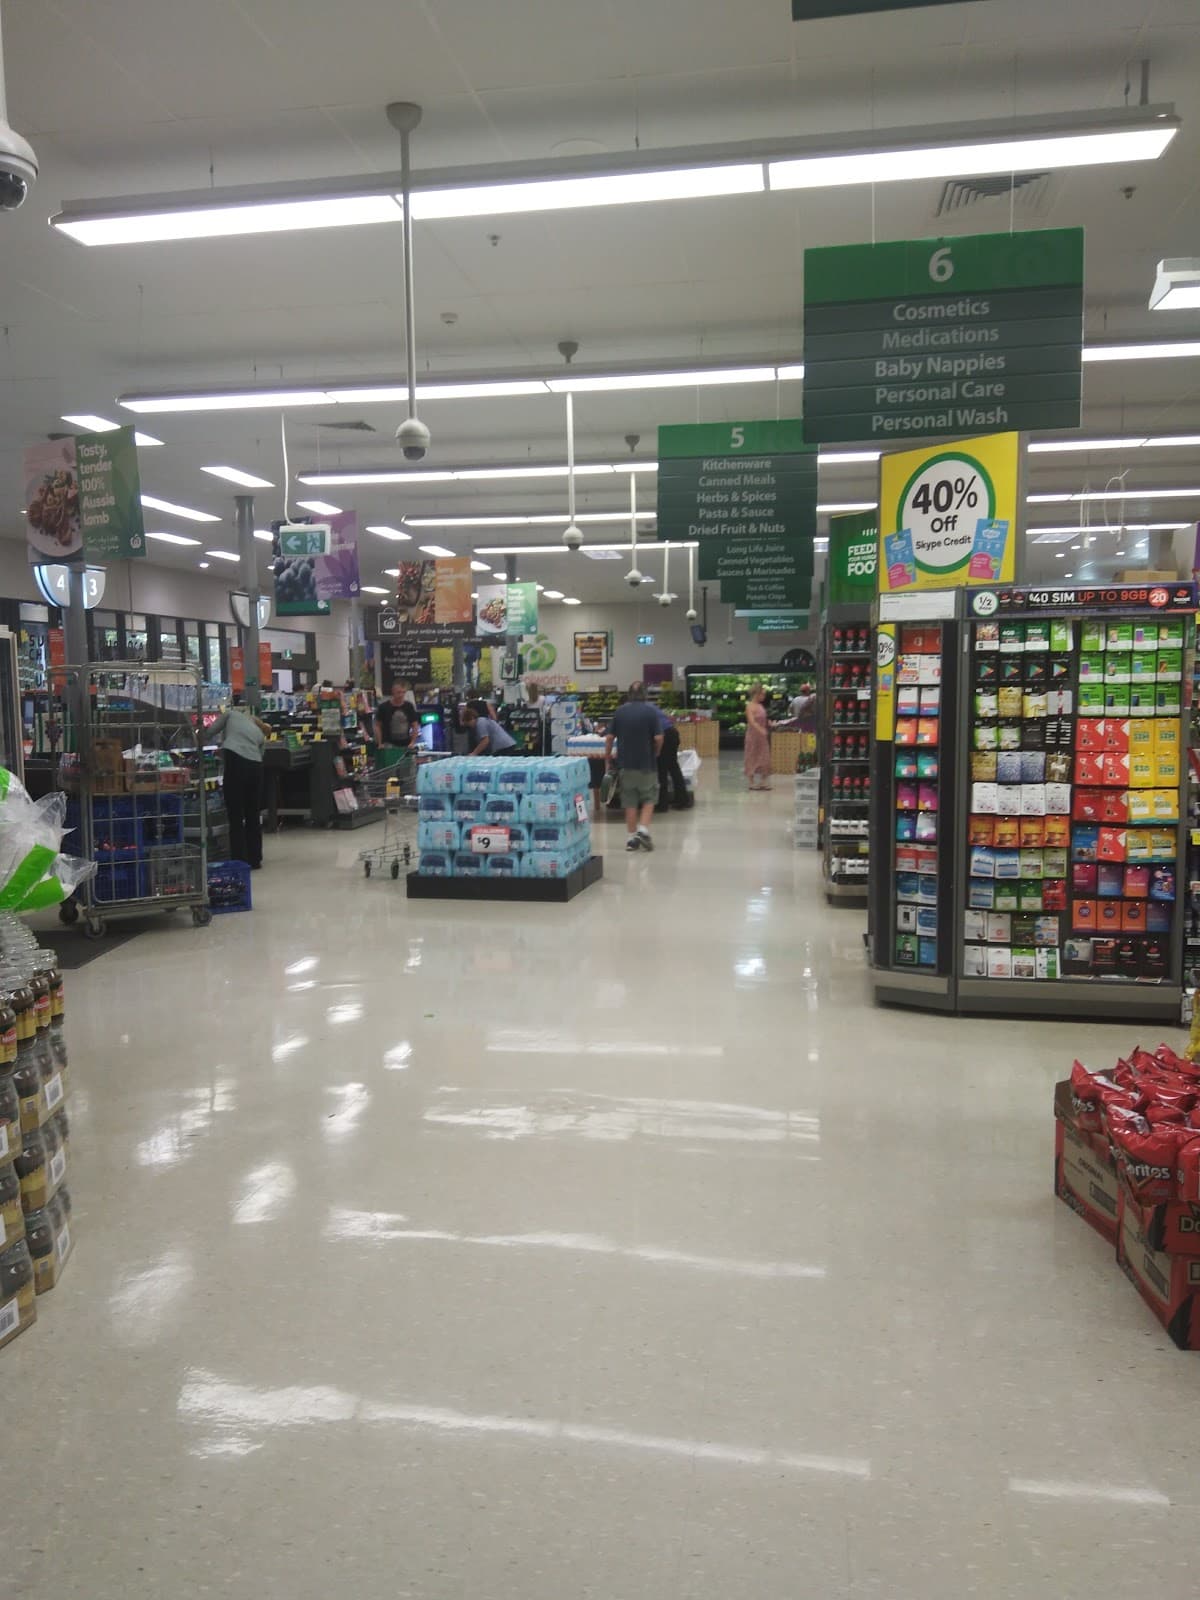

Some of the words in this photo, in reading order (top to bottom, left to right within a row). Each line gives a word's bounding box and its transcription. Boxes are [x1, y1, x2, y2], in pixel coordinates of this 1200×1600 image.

[929, 246, 954, 282] 6
[893, 299, 990, 321] Cosmetics
[883, 327, 999, 350] Medications
[875, 358, 921, 380] Baby
[927, 354, 1006, 376] Nappies
[876, 381, 957, 404] Personal
[961, 380, 1005, 399] Care
[872, 408, 953, 431] Personal
[957, 407, 1008, 427] Wash
[730, 427, 745, 448] 5
[80, 460, 112, 474] tender
[702, 459, 772, 471] Kitchenware
[81, 477, 105, 491] 100%
[699, 475, 742, 487] Canned
[743, 474, 776, 485] Meals
[83, 494, 116, 509] Aussie
[697, 492, 729, 503] Herbs
[731, 492, 740, 502] &
[742, 491, 777, 504] Spices
[912, 475, 978, 515] 40%
[699, 508, 730, 519] Pasta
[731, 508, 740, 518] &
[741, 507, 775, 517] Sauce
[688, 525, 719, 536] Dried
[721, 524, 747, 535] Fruit
[749, 524, 758, 534] &
[760, 523, 785, 534] Nuts
[930, 515, 958, 533] Off
[916, 540, 942, 551] Skype
[944, 536, 972, 547] Credit
[57, 574, 65, 589] 4
[89, 579, 98, 596] 3
[1052, 592, 1075, 603] SIM
[1077, 591, 1095, 602] UP
[1098, 591, 1117, 601] TO
[477, 837, 491, 849] $9
[1126, 1163, 1171, 1180] oritos
